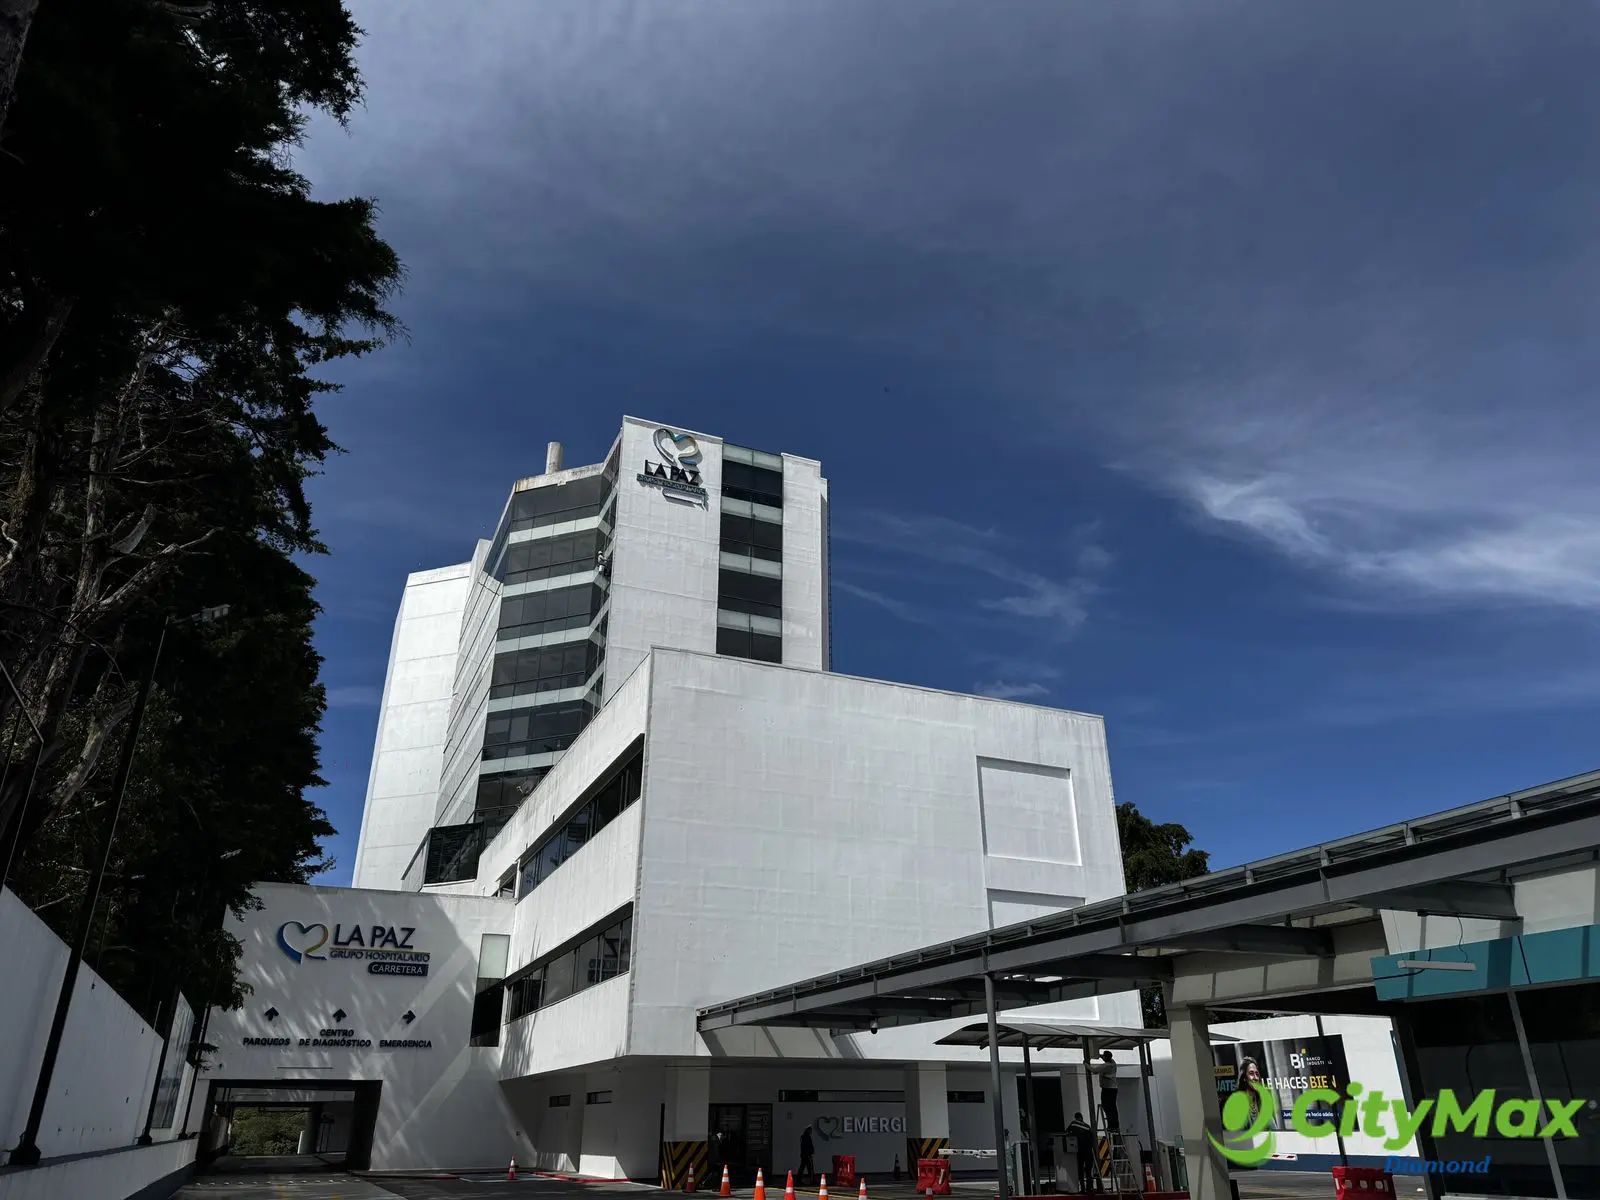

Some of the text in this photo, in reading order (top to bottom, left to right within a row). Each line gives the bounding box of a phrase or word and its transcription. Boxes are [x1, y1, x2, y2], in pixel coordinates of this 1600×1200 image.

[645, 459, 668, 480] LA
[670, 465, 701, 486] PAZ
[333, 923, 416, 949] LA PAZ
[330, 950, 431, 962] GRUPO HOSPITALARIO
[371, 963, 424, 974] CARRETERA
[319, 1029, 354, 1037] CENTRO
[242, 1037, 291, 1046] PARQUEOS
[298, 1037, 372, 1047] DE DIAGNÓSTICO
[379, 1039, 432, 1048] EMERGENCIA
[1289, 1048, 1307, 1069] Bi
[1274, 1076, 1309, 1090] HACES
